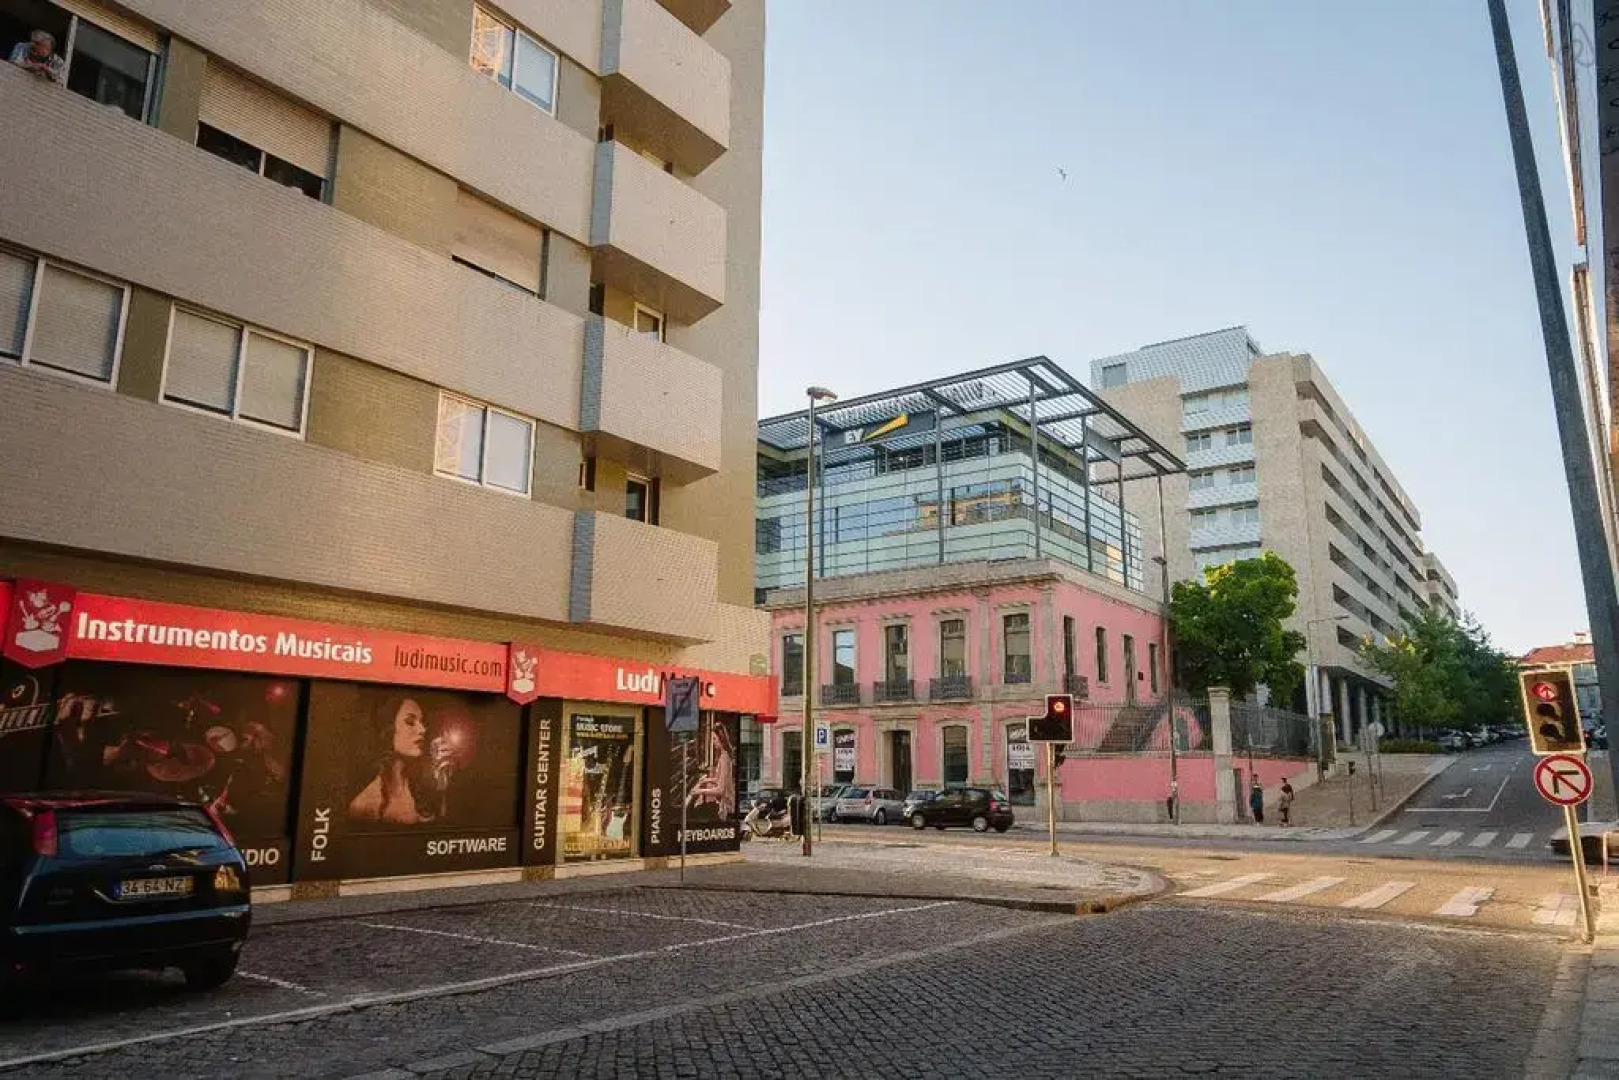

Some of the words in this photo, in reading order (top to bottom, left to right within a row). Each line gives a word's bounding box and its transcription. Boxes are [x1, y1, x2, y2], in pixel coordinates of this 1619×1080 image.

[844, 428, 864, 444] EY
[77, 612, 267, 653] Instrumentos
[275, 632, 373, 664] Musicais
[394, 645, 502, 677] ludimusic.com
[537, 719, 552, 784] CENTER
[818, 730, 825, 743] P
[533, 788, 548, 850] GUITAR
[651, 788, 662, 844] PIANOS
[311, 808, 330, 862] FOLK
[427, 837, 507, 856] SOFTWARE
[677, 827, 736, 842] KEYBOARDS
[242, 848, 279, 867] DIO
